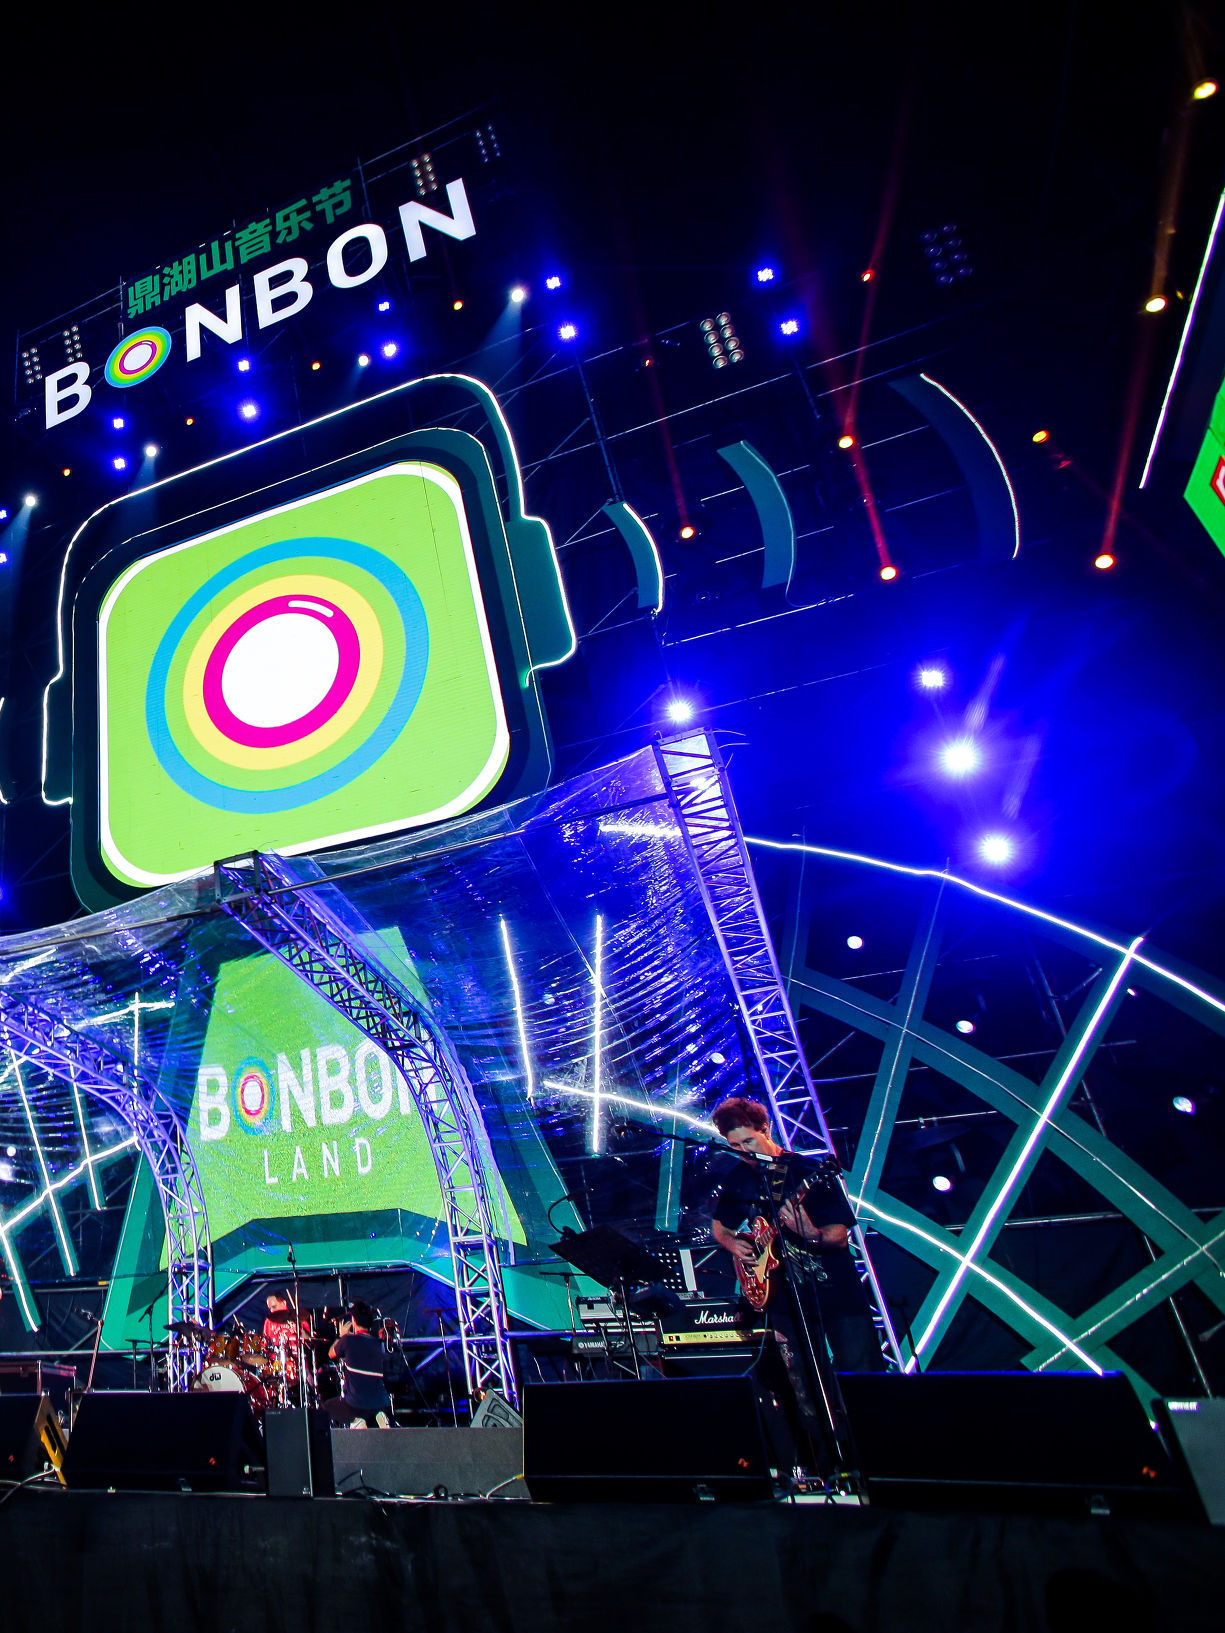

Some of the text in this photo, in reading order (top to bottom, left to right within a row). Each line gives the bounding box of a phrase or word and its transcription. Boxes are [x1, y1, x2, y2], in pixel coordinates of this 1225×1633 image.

[127, 178, 352, 319] 鼎湖山音乐节
[264, 1137, 374, 1184] LAND
